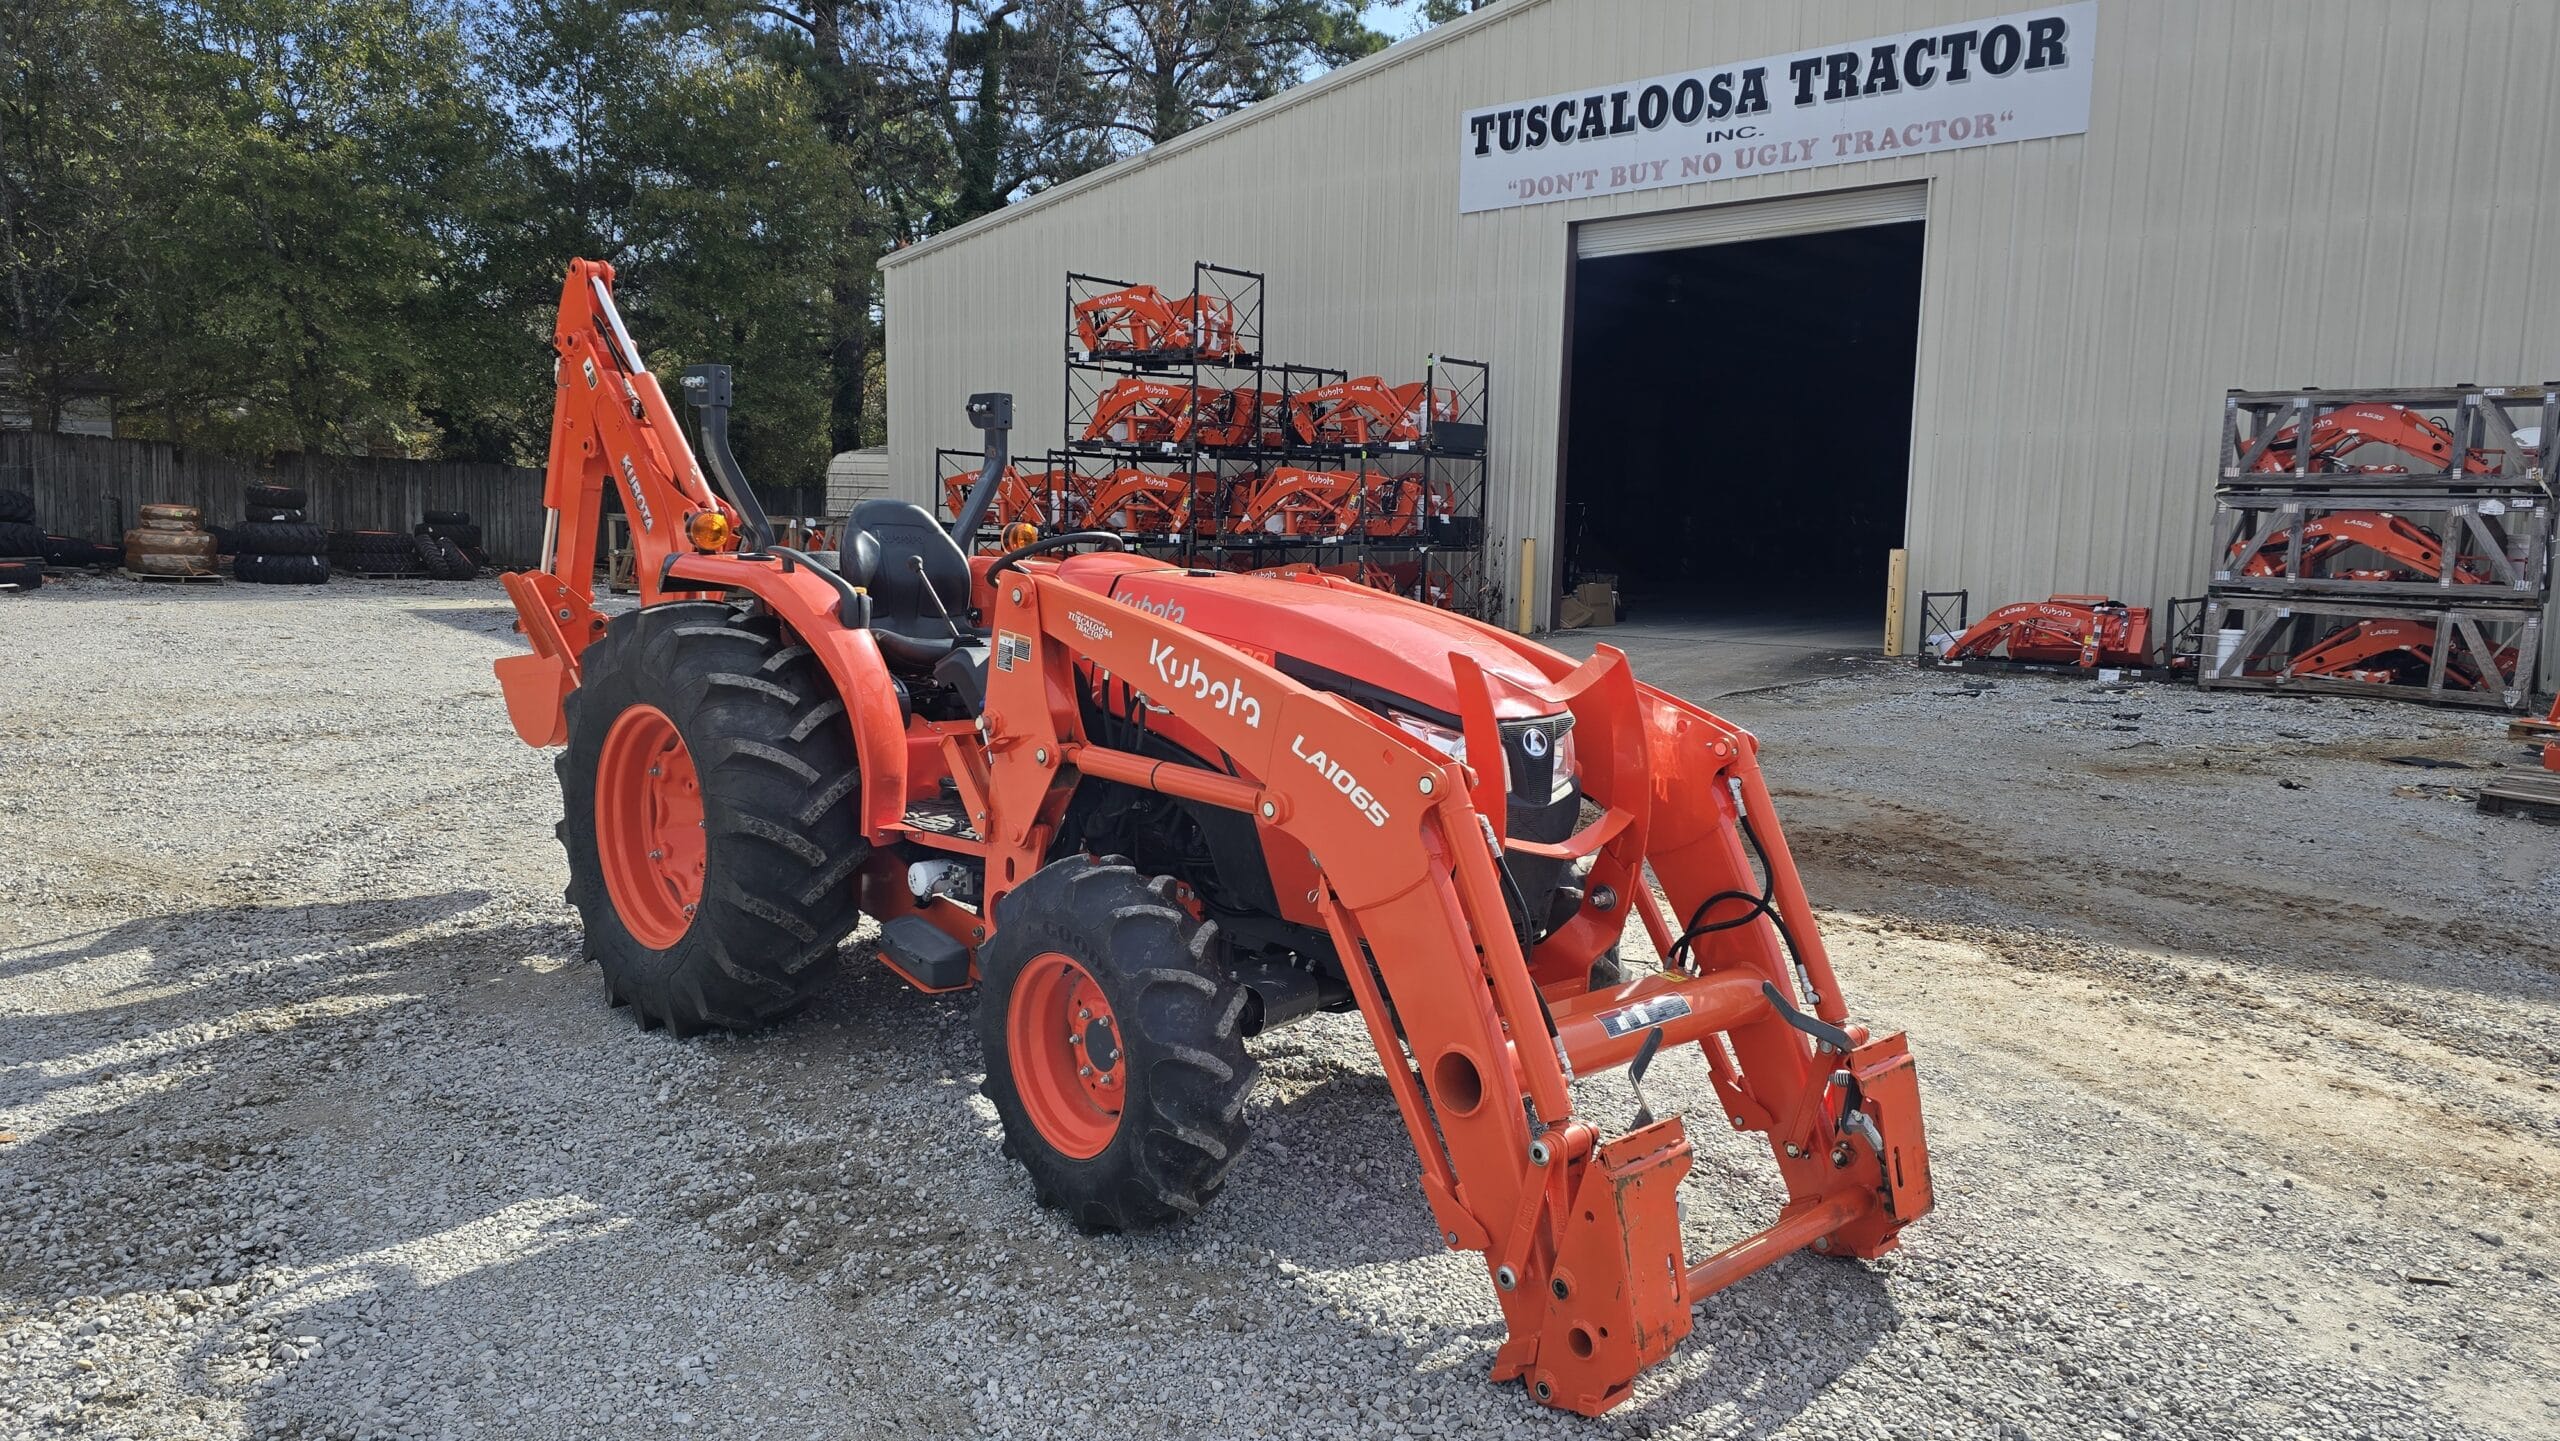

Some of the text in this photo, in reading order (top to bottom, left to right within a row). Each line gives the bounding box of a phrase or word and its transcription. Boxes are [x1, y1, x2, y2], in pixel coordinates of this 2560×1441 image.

[1471, 16, 2070, 158] TUSCALOOSA TRACTOR
[1706, 126, 1765, 144] INC.
[1610, 159, 1669, 187] BUY
[1680, 152, 1722, 178] NO
[1734, 138, 1819, 170] UGLY
[1098, 294, 1122, 306] Kubota
[1144, 384, 1169, 396] Kubota
[1318, 386, 1344, 399] Kubota
[1144, 475, 1169, 488] Kubota
[1307, 473, 1335, 486] Kubota
[621, 453, 655, 535] KUBOTA
[2039, 604, 2072, 618] Kubota
[1067, 611, 1113, 639] TUSCALOOSA
[1075, 622, 1104, 641] TRACTOR
[1149, 638, 1261, 729] Kubota
[1292, 734, 1391, 827] LA1065
